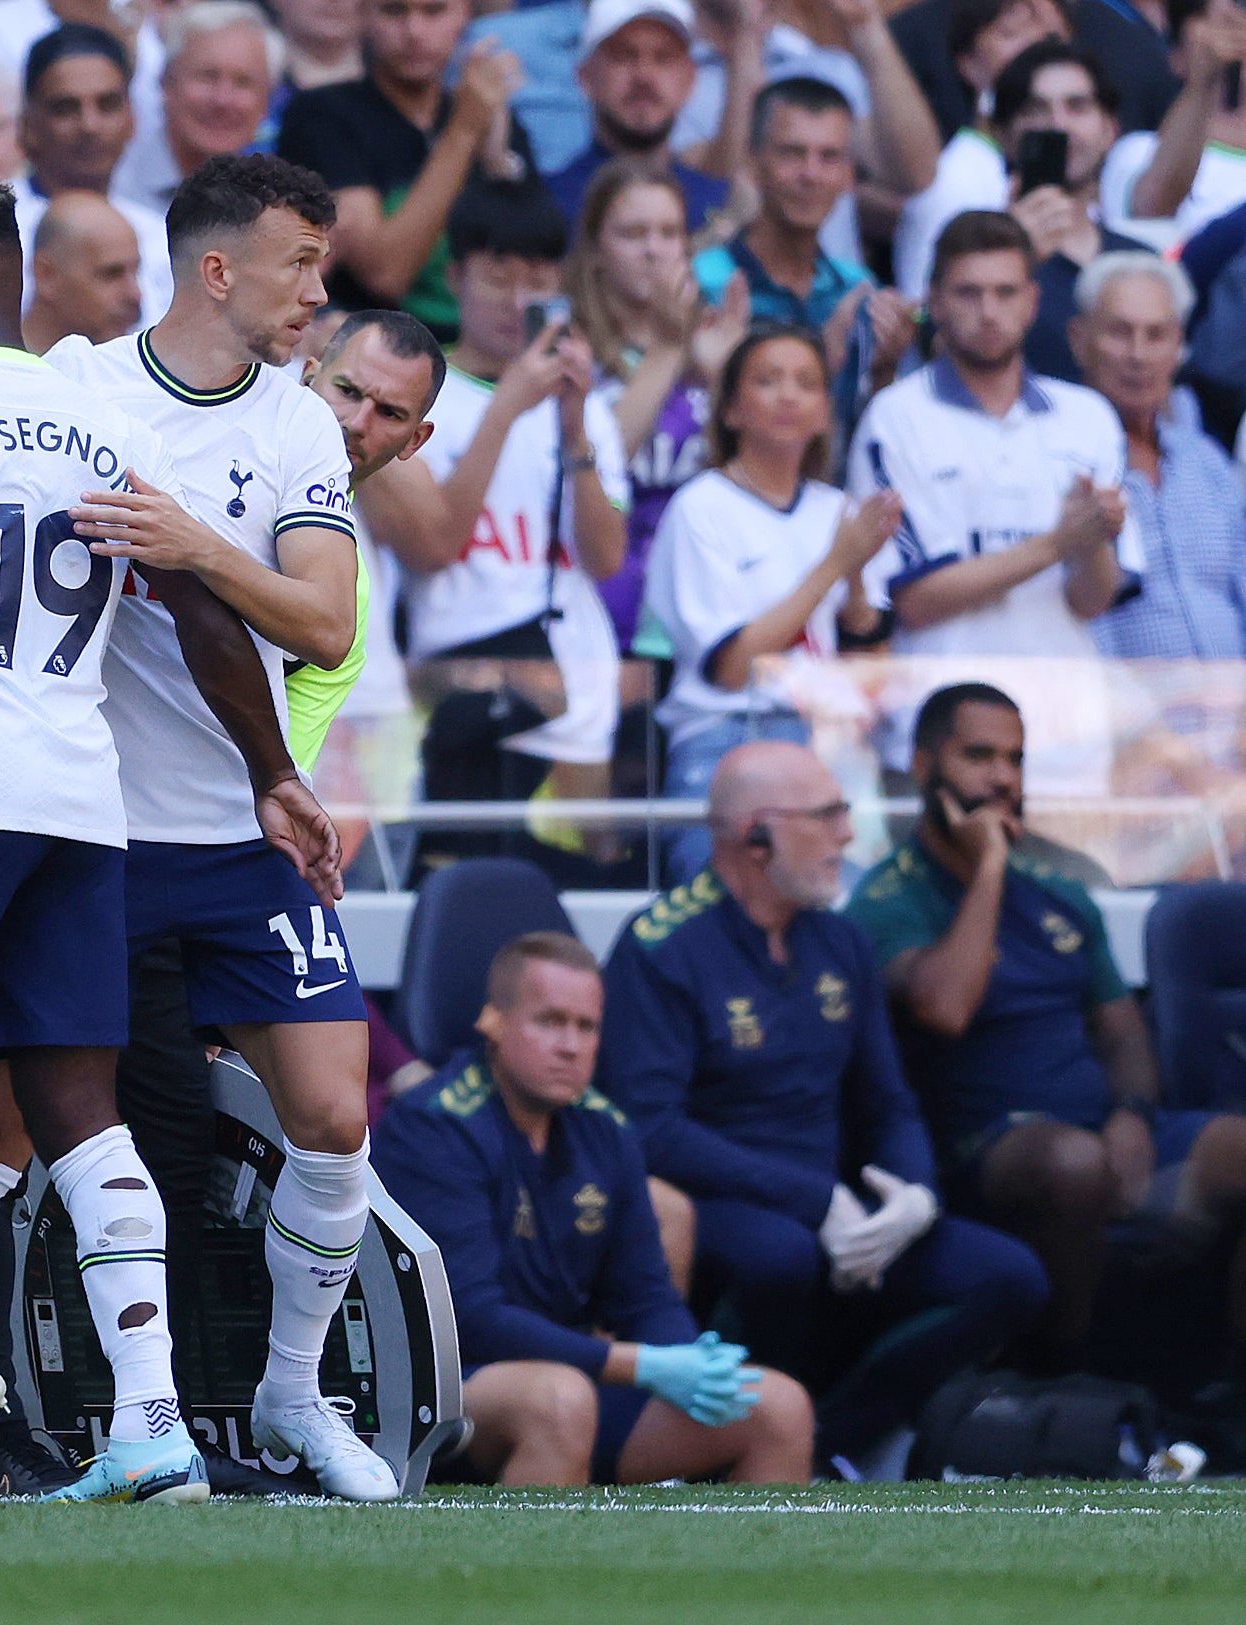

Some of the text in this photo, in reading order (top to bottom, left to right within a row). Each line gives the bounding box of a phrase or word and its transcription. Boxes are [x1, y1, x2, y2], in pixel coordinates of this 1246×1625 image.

[306, 478, 350, 512] cin
[268, 905, 348, 975] 14
[248, 1136, 266, 1157] 05
